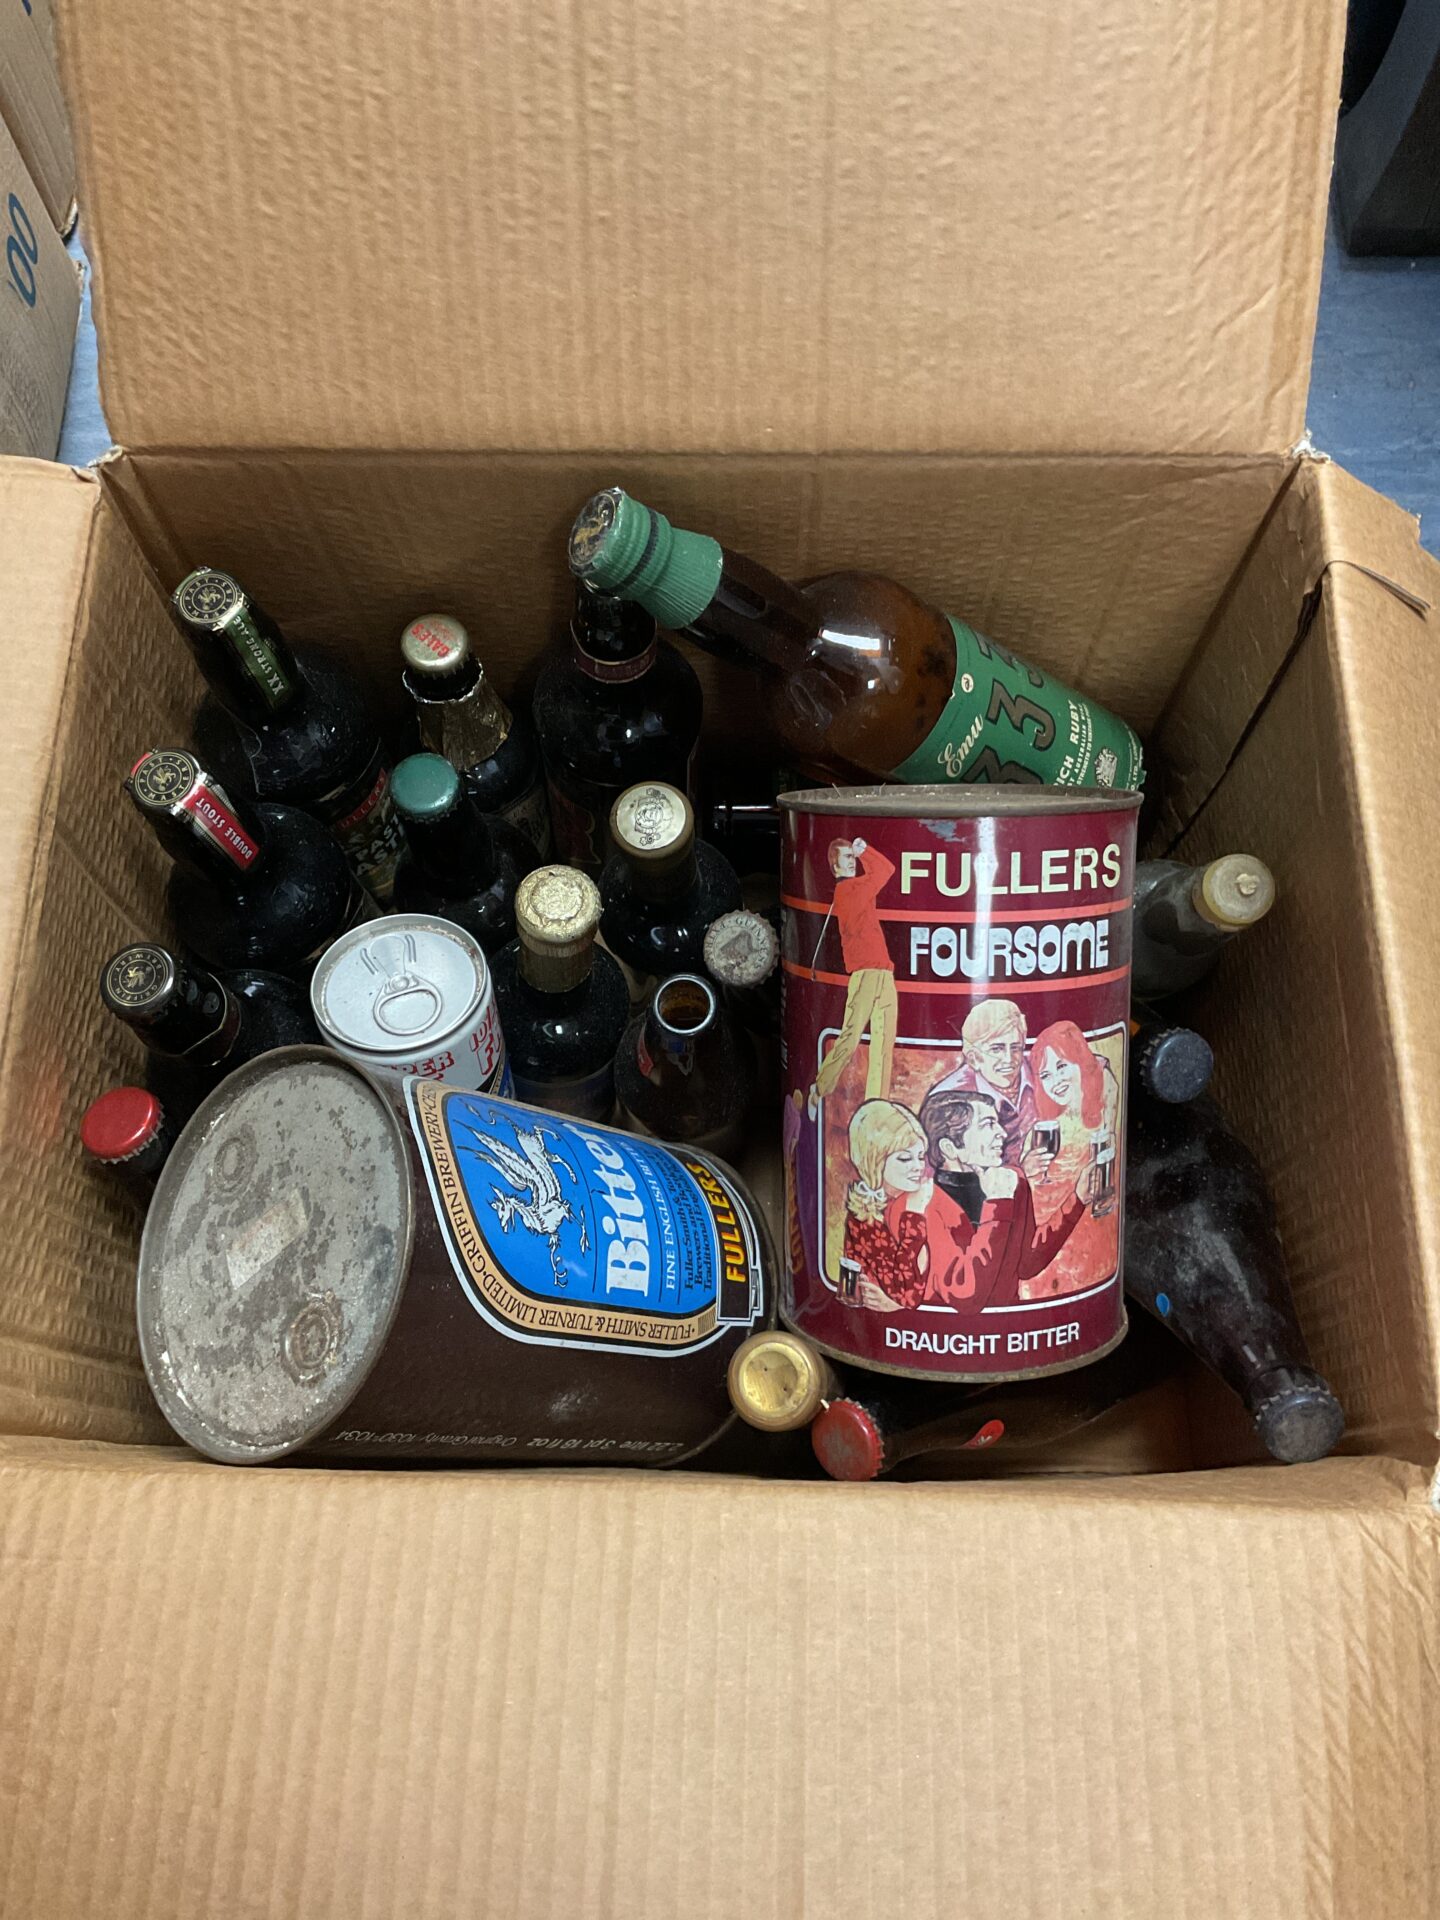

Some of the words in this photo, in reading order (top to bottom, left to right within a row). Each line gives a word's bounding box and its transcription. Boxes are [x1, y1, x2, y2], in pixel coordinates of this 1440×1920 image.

[233, 615, 250, 636] ALE
[246, 637, 272, 674] STRONG
[267, 673, 284, 695] XX
[937, 713, 984, 778] Emu
[1053, 755, 1074, 786] ICH
[1068, 700, 1079, 745] RUBY
[139, 757, 164, 784] PAST
[147, 759, 191, 801] MASTERS
[195, 798, 226, 829] STOUT
[224, 827, 253, 859] DOUBLE
[899, 842, 1122, 899] FULLERS
[115, 953, 162, 972] BREWERY
[735, 915, 770, 970] GUINNESS
[909, 919, 1110, 977] FOURSOME
[114, 984, 158, 1001] GRIFFIN
[423, 1111, 458, 1191] BREWERY
[562, 1122, 650, 1297] Bitter
[647, 1179, 675, 1246] ENGLISH
[676, 1206, 692, 1247] Smith
[686, 1162, 746, 1283] FULLERS
[447, 1192, 487, 1274] GRIFFIN
[665, 1249, 676, 1290] FINE
[684, 1246, 694, 1290] Fuller
[694, 1228, 703, 1285] Brewers
[695, 1216, 713, 1292] Traditional
[483, 1280, 537, 1329] LIMITED
[540, 1309, 595, 1332] TURNER
[595, 1316, 605, 1332] &
[605, 1317, 645, 1337] SMITH
[649, 1322, 691, 1341] FULLER
[885, 1326, 1001, 1355] DRAUGHT
[1006, 1321, 1080, 1354] BITTER
[421, 1433, 469, 1446] Gravity
[467, 1435, 518, 1447] Original
[526, 1437, 551, 1447] oz
